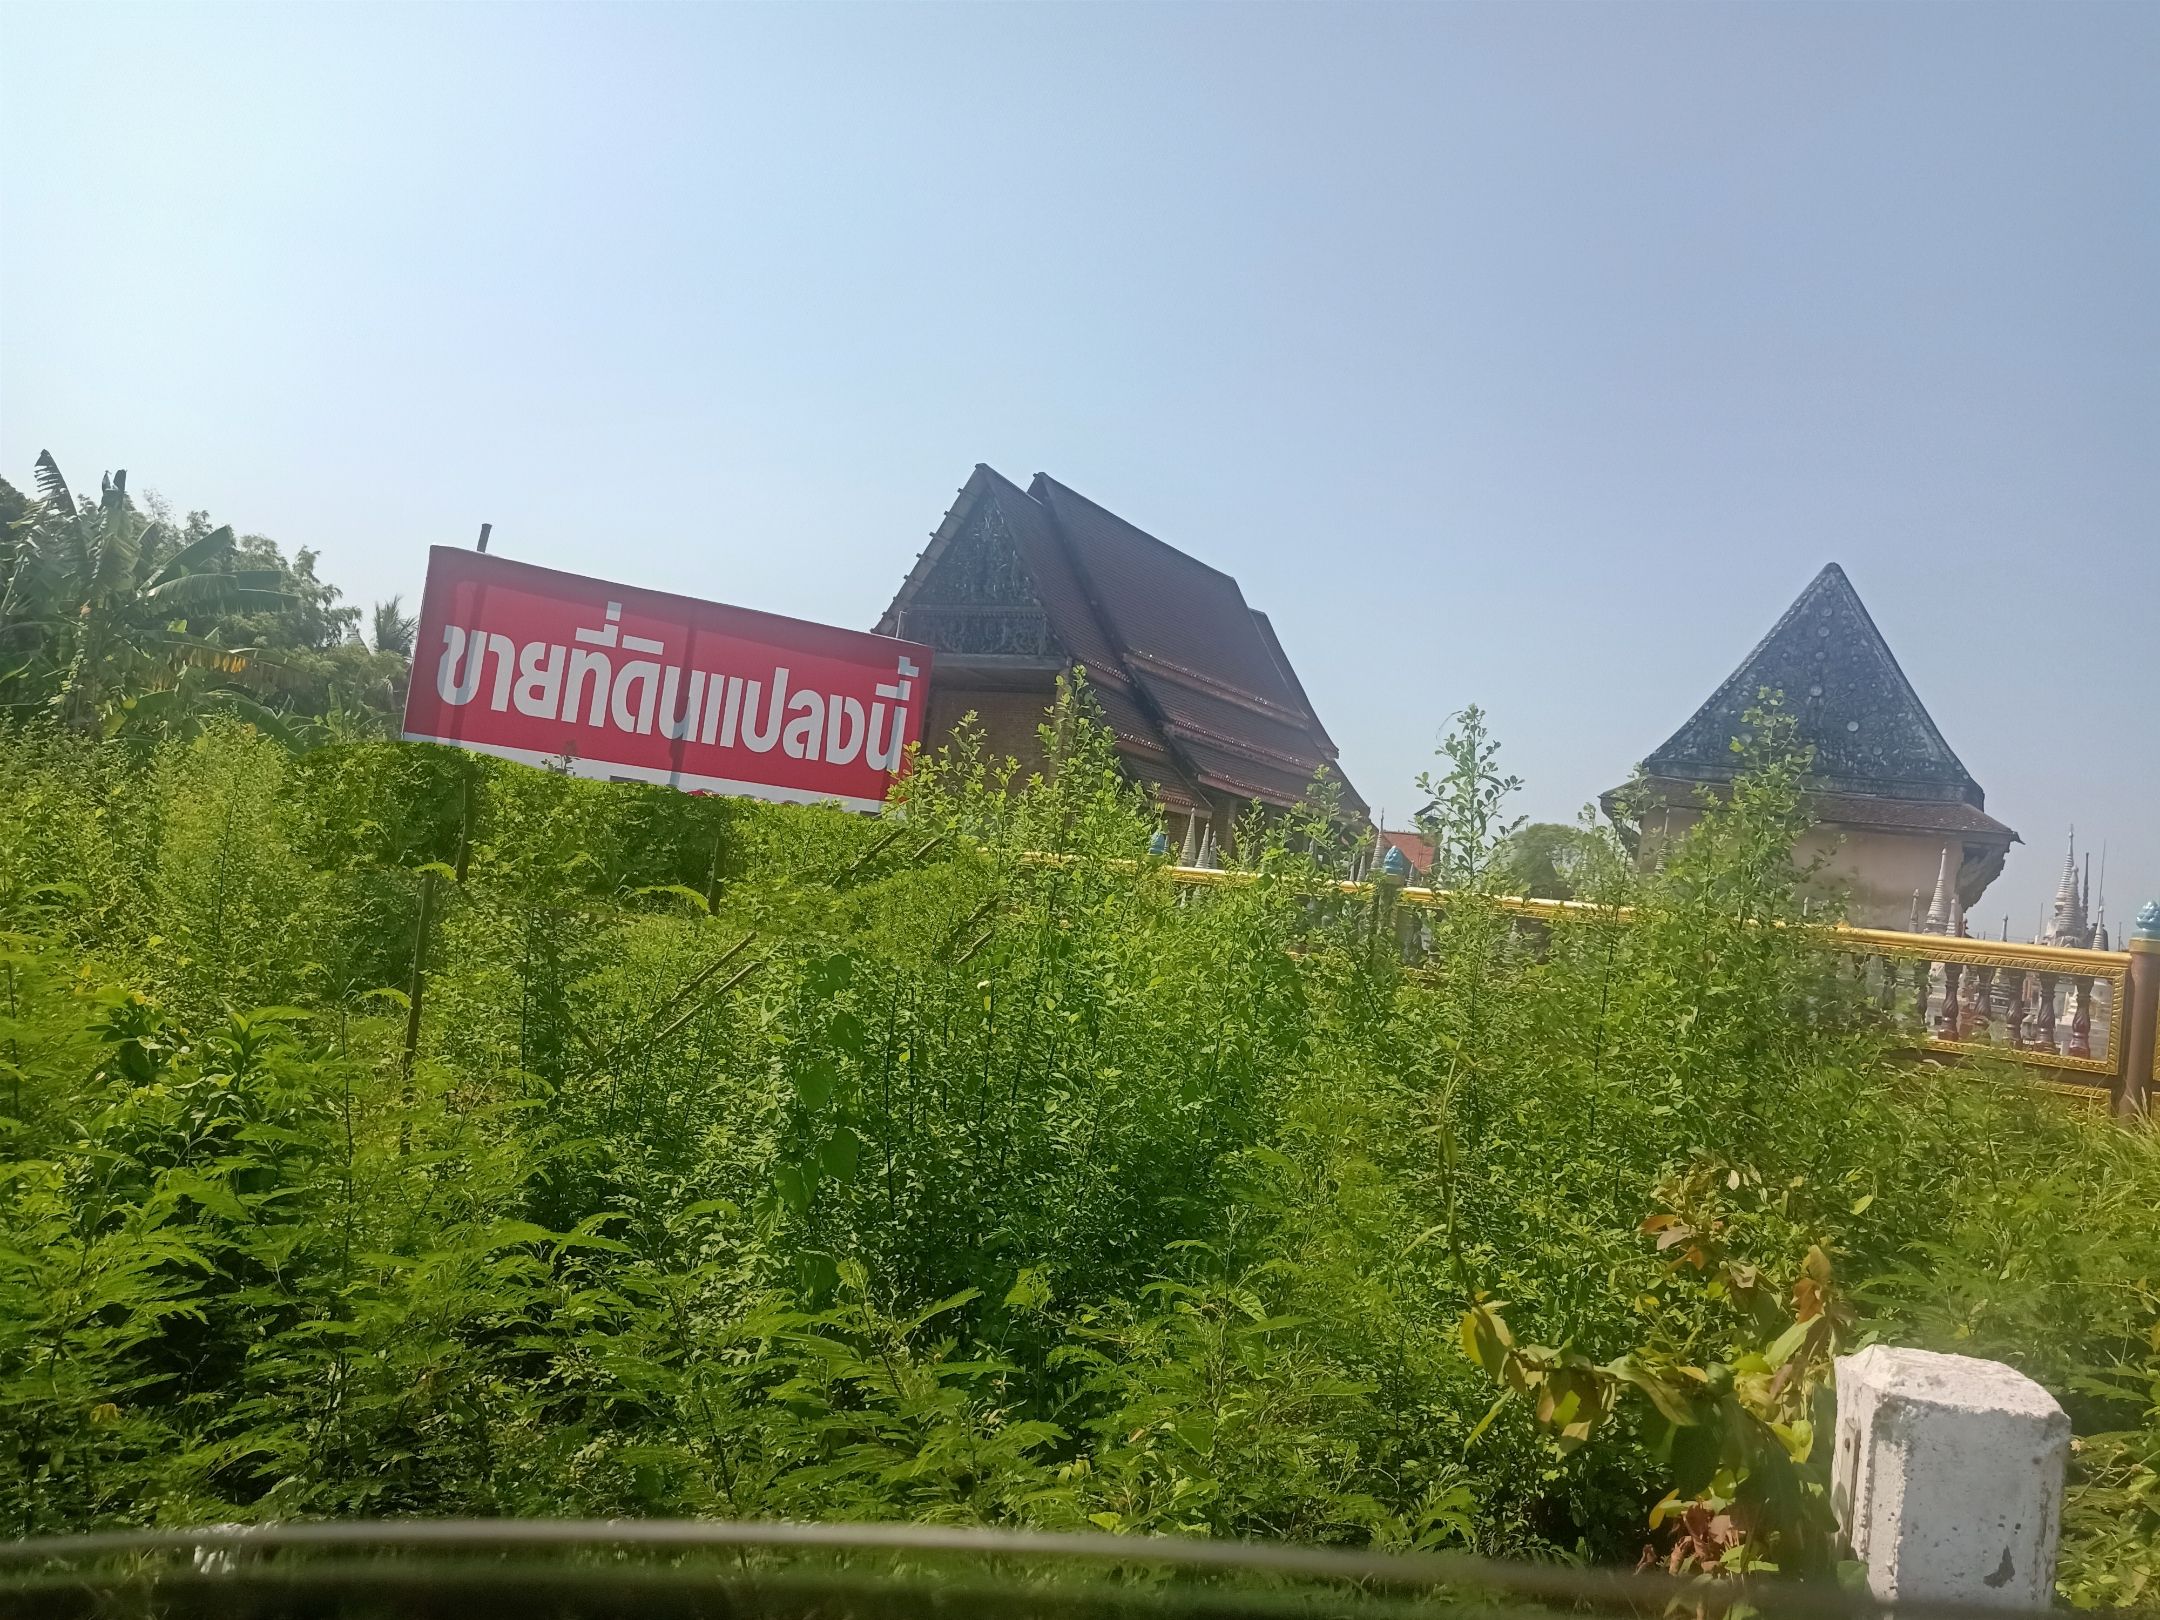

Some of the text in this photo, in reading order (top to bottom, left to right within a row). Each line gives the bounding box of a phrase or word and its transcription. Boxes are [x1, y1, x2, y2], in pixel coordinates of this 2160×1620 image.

[437, 601, 920, 772] ขายที่ดินแปลงนี้
